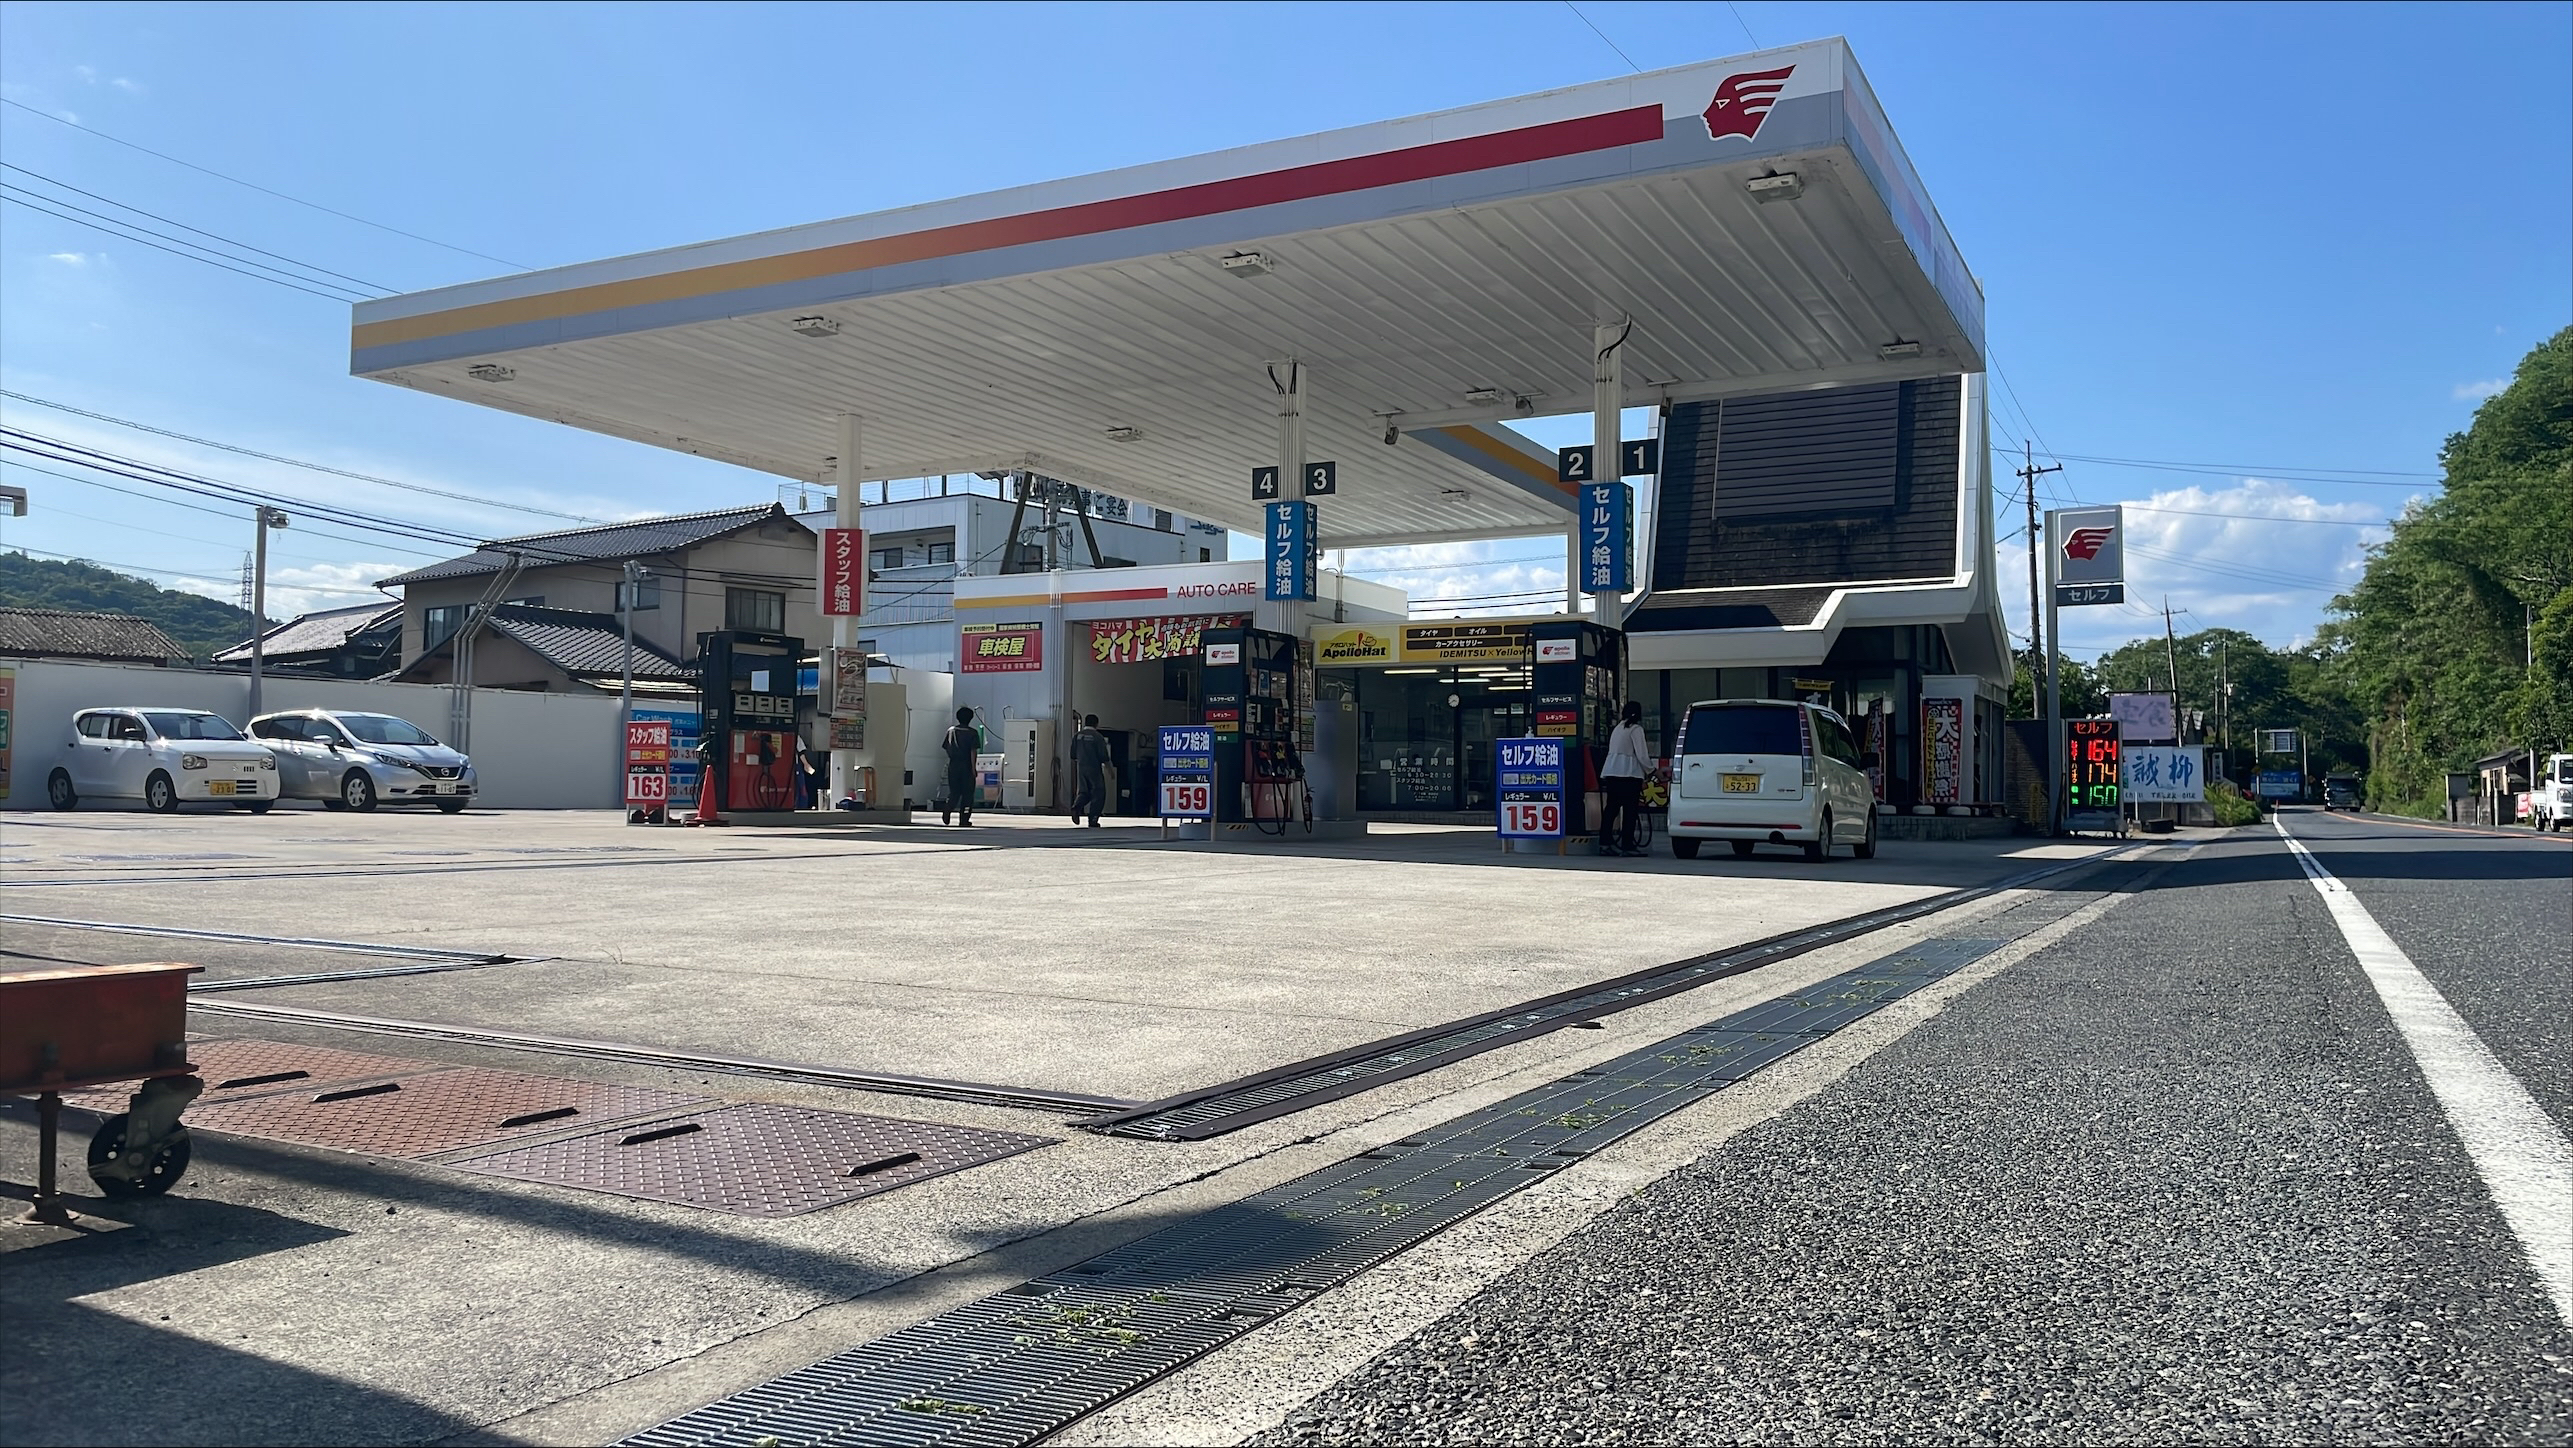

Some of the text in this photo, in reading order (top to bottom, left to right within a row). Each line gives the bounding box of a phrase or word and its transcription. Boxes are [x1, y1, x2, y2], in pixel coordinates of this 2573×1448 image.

[1568, 452, 1584, 476] 2
[1633, 446, 1645, 469] 1
[1259, 472, 1274, 494] 4
[1313, 467, 1327, 490] 3
[1591, 486, 1611, 586] セルフ給油
[1275, 504, 1293, 596] セルフ給油
[1305, 504, 1314, 596] セルフ給油
[834, 532, 851, 613] スタッフ給油
[1177, 581, 1256, 599] AUTO CARE
[2068, 588, 2112, 602] セルフ
[1092, 621, 1124, 630] ヨコハマ
[978, 637, 1025, 656] 車検屋
[1321, 646, 1387, 659] ApolloHat
[1435, 640, 1483, 648] カーアクセサリー
[1439, 649, 1487, 658] IDEMITSU
[630, 726, 668, 745] スタッフ給油
[2074, 722, 2112, 734] セルフ
[1162, 731, 1210, 751] セルフ給油
[2087, 739, 2117, 761] 164
[1502, 744, 1559, 766] セルフ給油
[1165, 775, 1187, 783] レギュラー
[2088, 763, 2117, 783] 174
[632, 775, 664, 798] 163
[1504, 792, 1530, 800] レギュラー
[2089, 785, 2117, 806] 150
[1166, 787, 1207, 811] 159
[1506, 806, 1558, 831] 159
